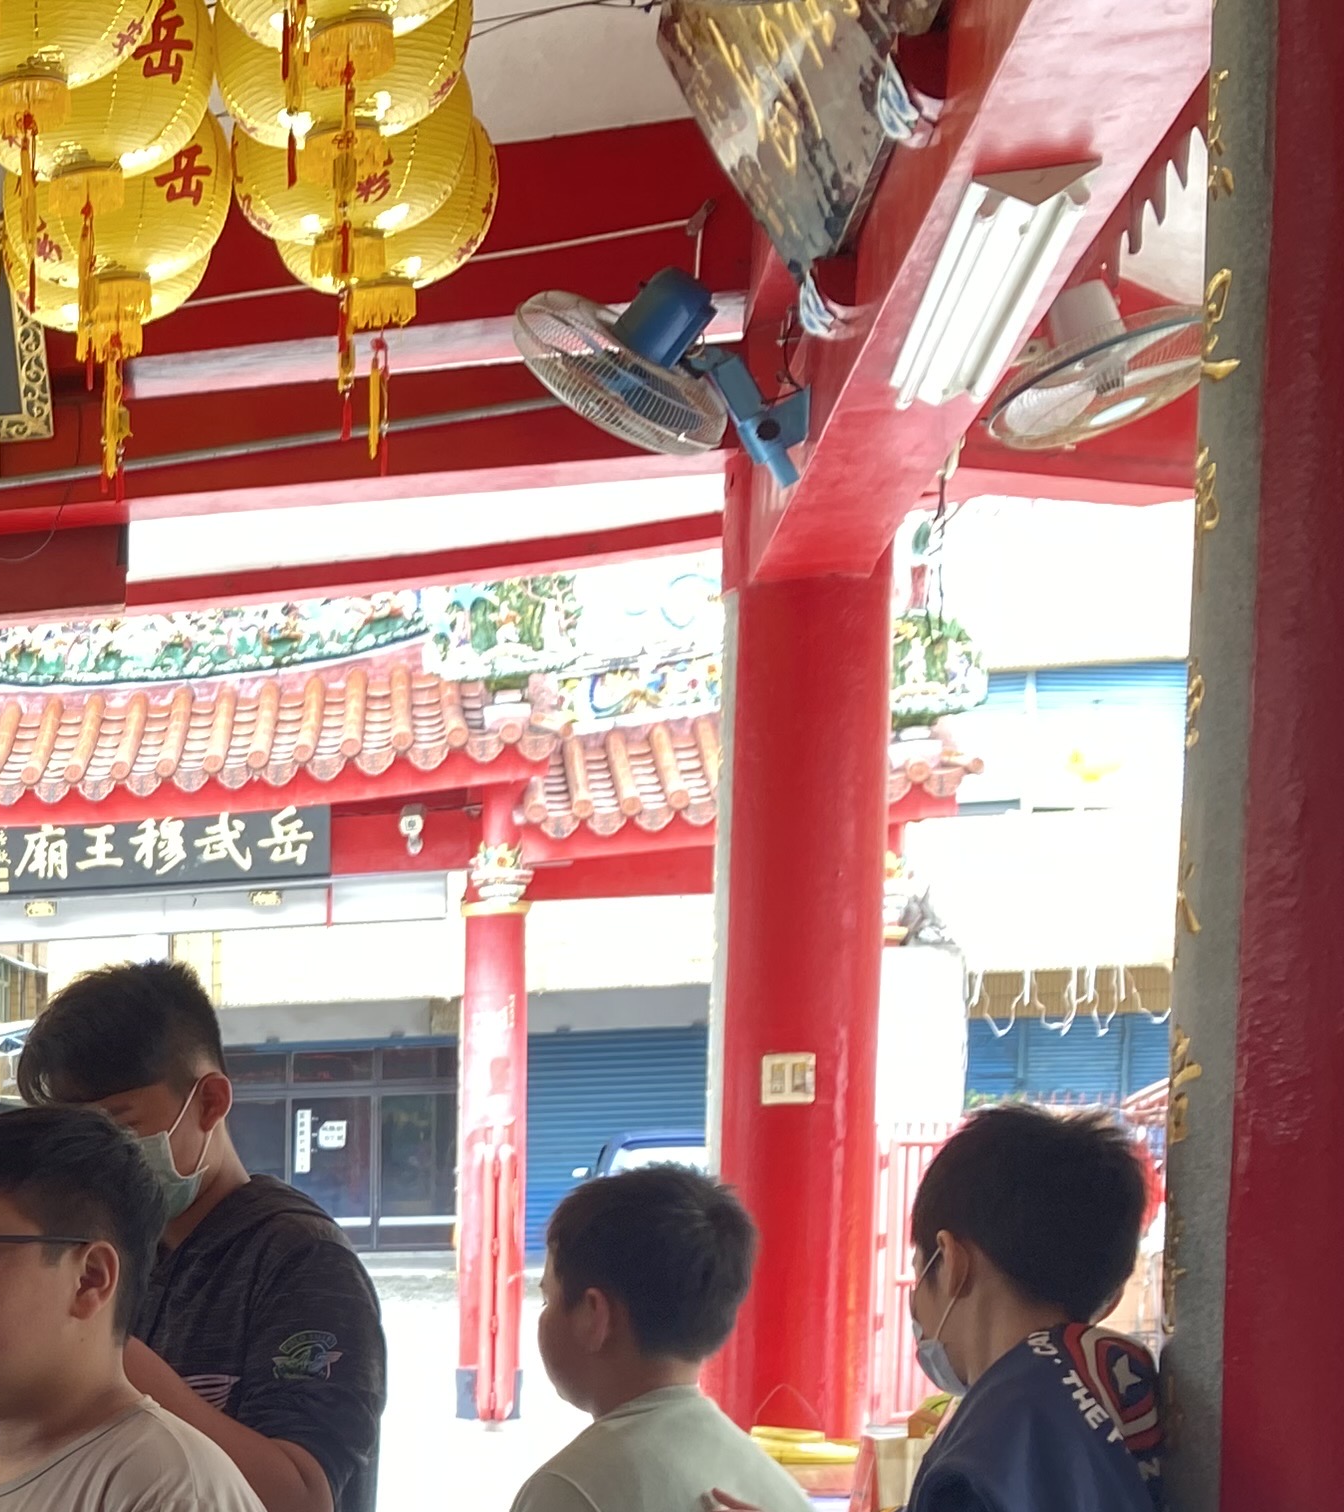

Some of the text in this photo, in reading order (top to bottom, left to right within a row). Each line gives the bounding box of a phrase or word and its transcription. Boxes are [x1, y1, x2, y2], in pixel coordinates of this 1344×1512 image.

[132, 0, 193, 84] 岳
[154, 144, 212, 206] 岳
[14, 805, 314, 880] 岳武穆王廟
[1062, 1369, 1110, 1430] THE
